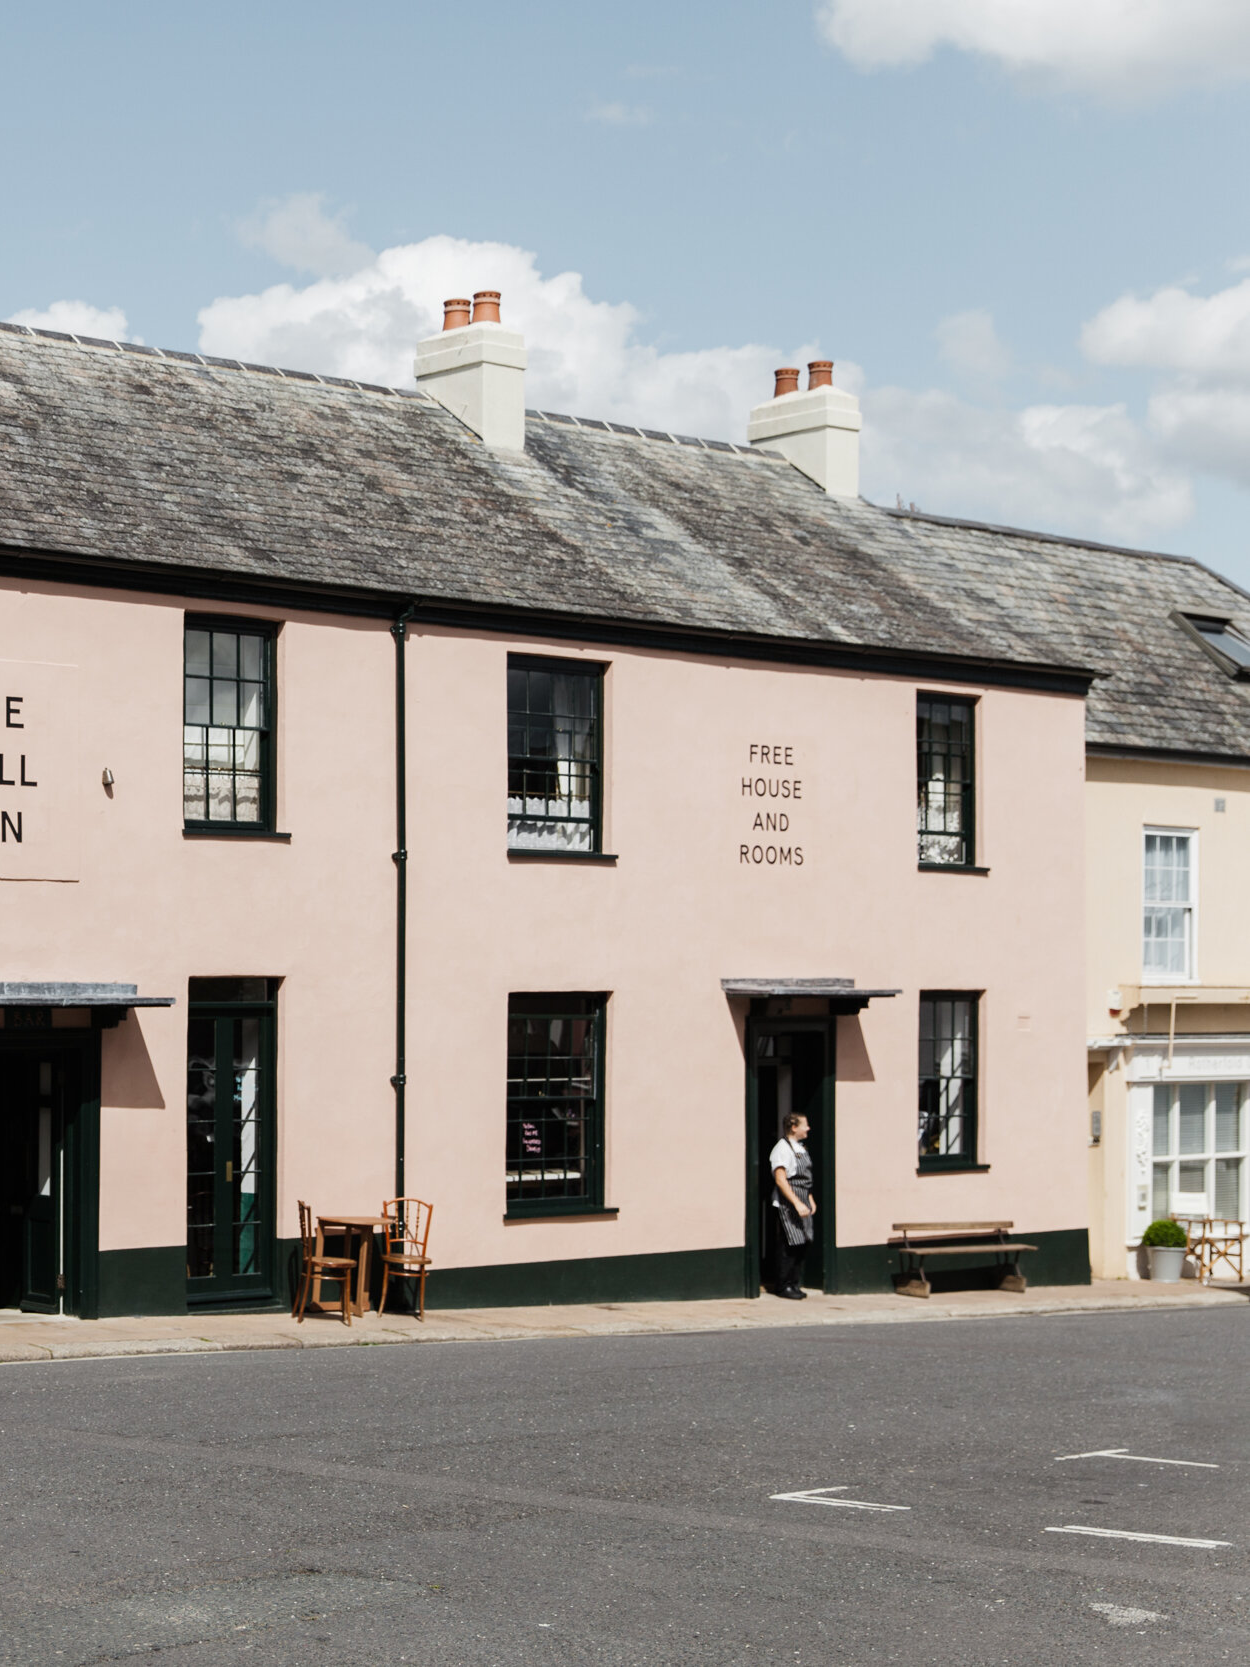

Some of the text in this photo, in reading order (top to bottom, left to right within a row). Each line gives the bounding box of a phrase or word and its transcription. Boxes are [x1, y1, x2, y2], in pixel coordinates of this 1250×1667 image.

[749, 744, 794, 766] FREE
[741, 777, 802, 799] HOUSE
[752, 812, 790, 832] AND
[739, 844, 804, 866] ROOMS
